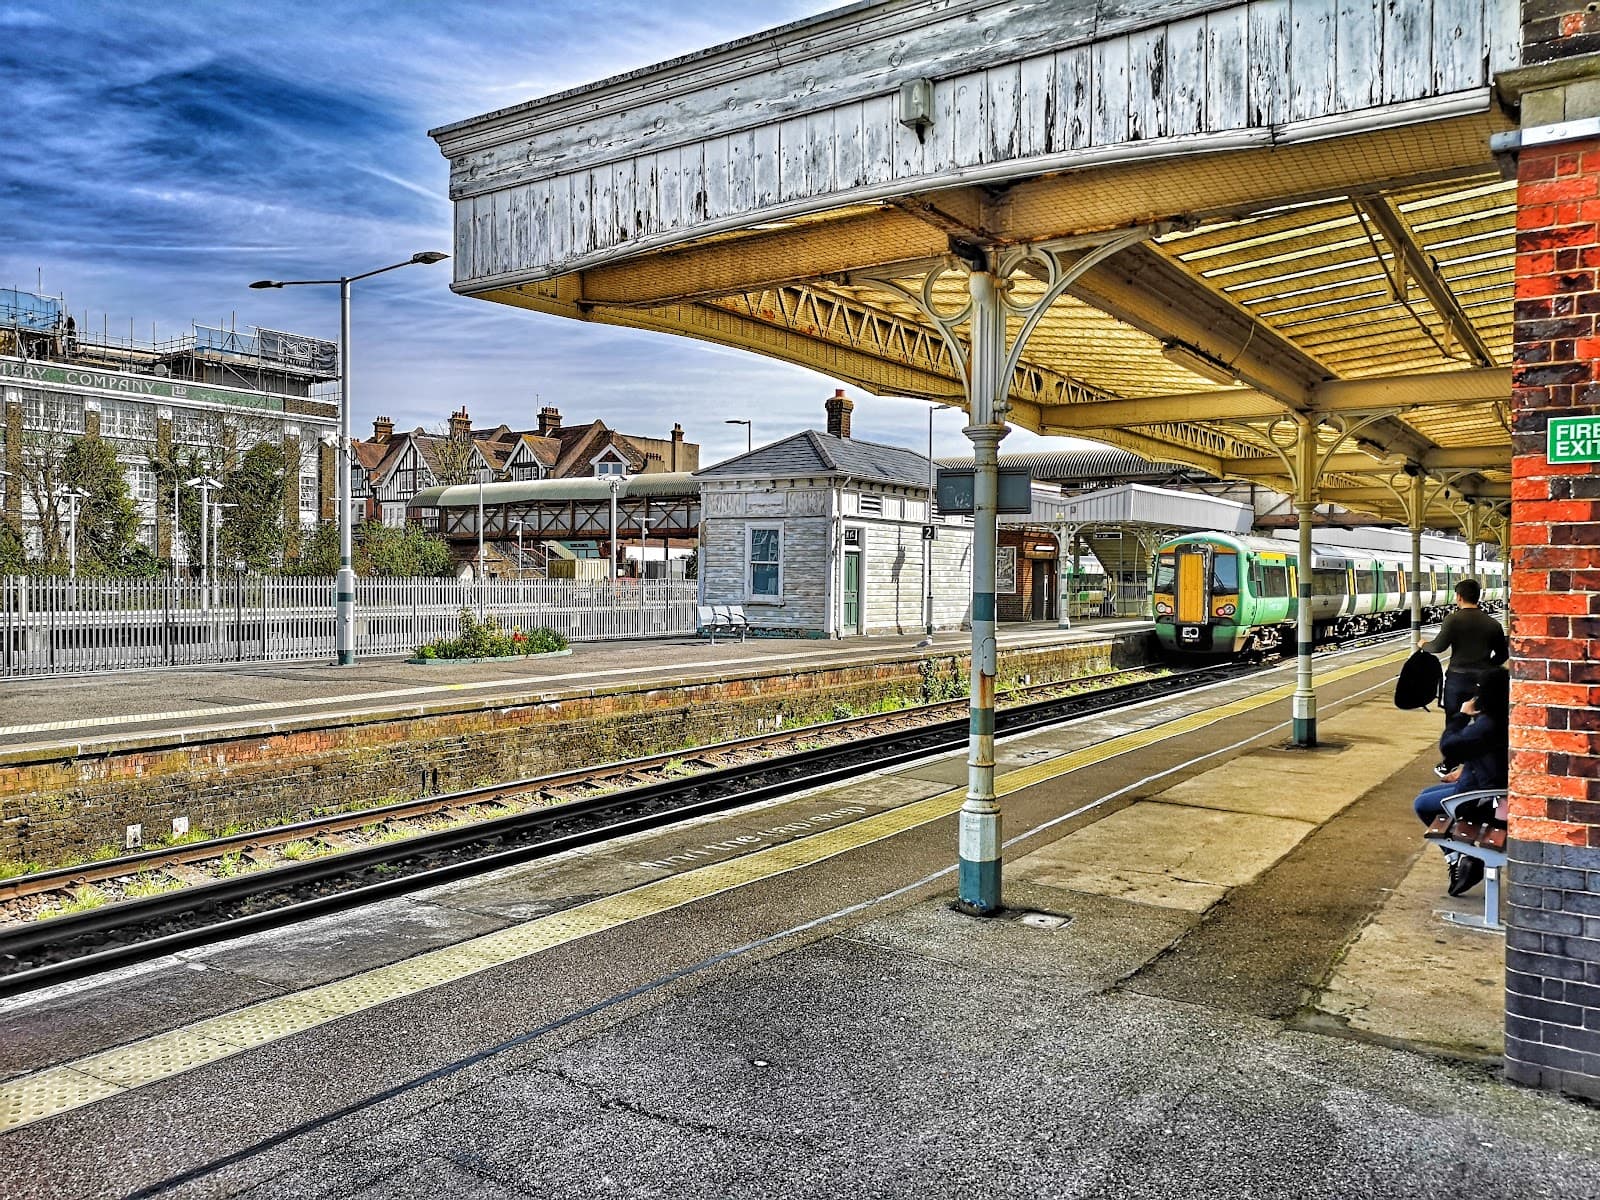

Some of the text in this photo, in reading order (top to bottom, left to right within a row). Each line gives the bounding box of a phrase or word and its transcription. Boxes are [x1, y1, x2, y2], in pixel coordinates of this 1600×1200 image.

[66, 372, 155, 393] COMPANY
[1556, 422, 1600, 441] FIRE
[1556, 440, 1600, 457] EXIT
[925, 527, 932, 539] 2
[704, 835, 761, 851] the
